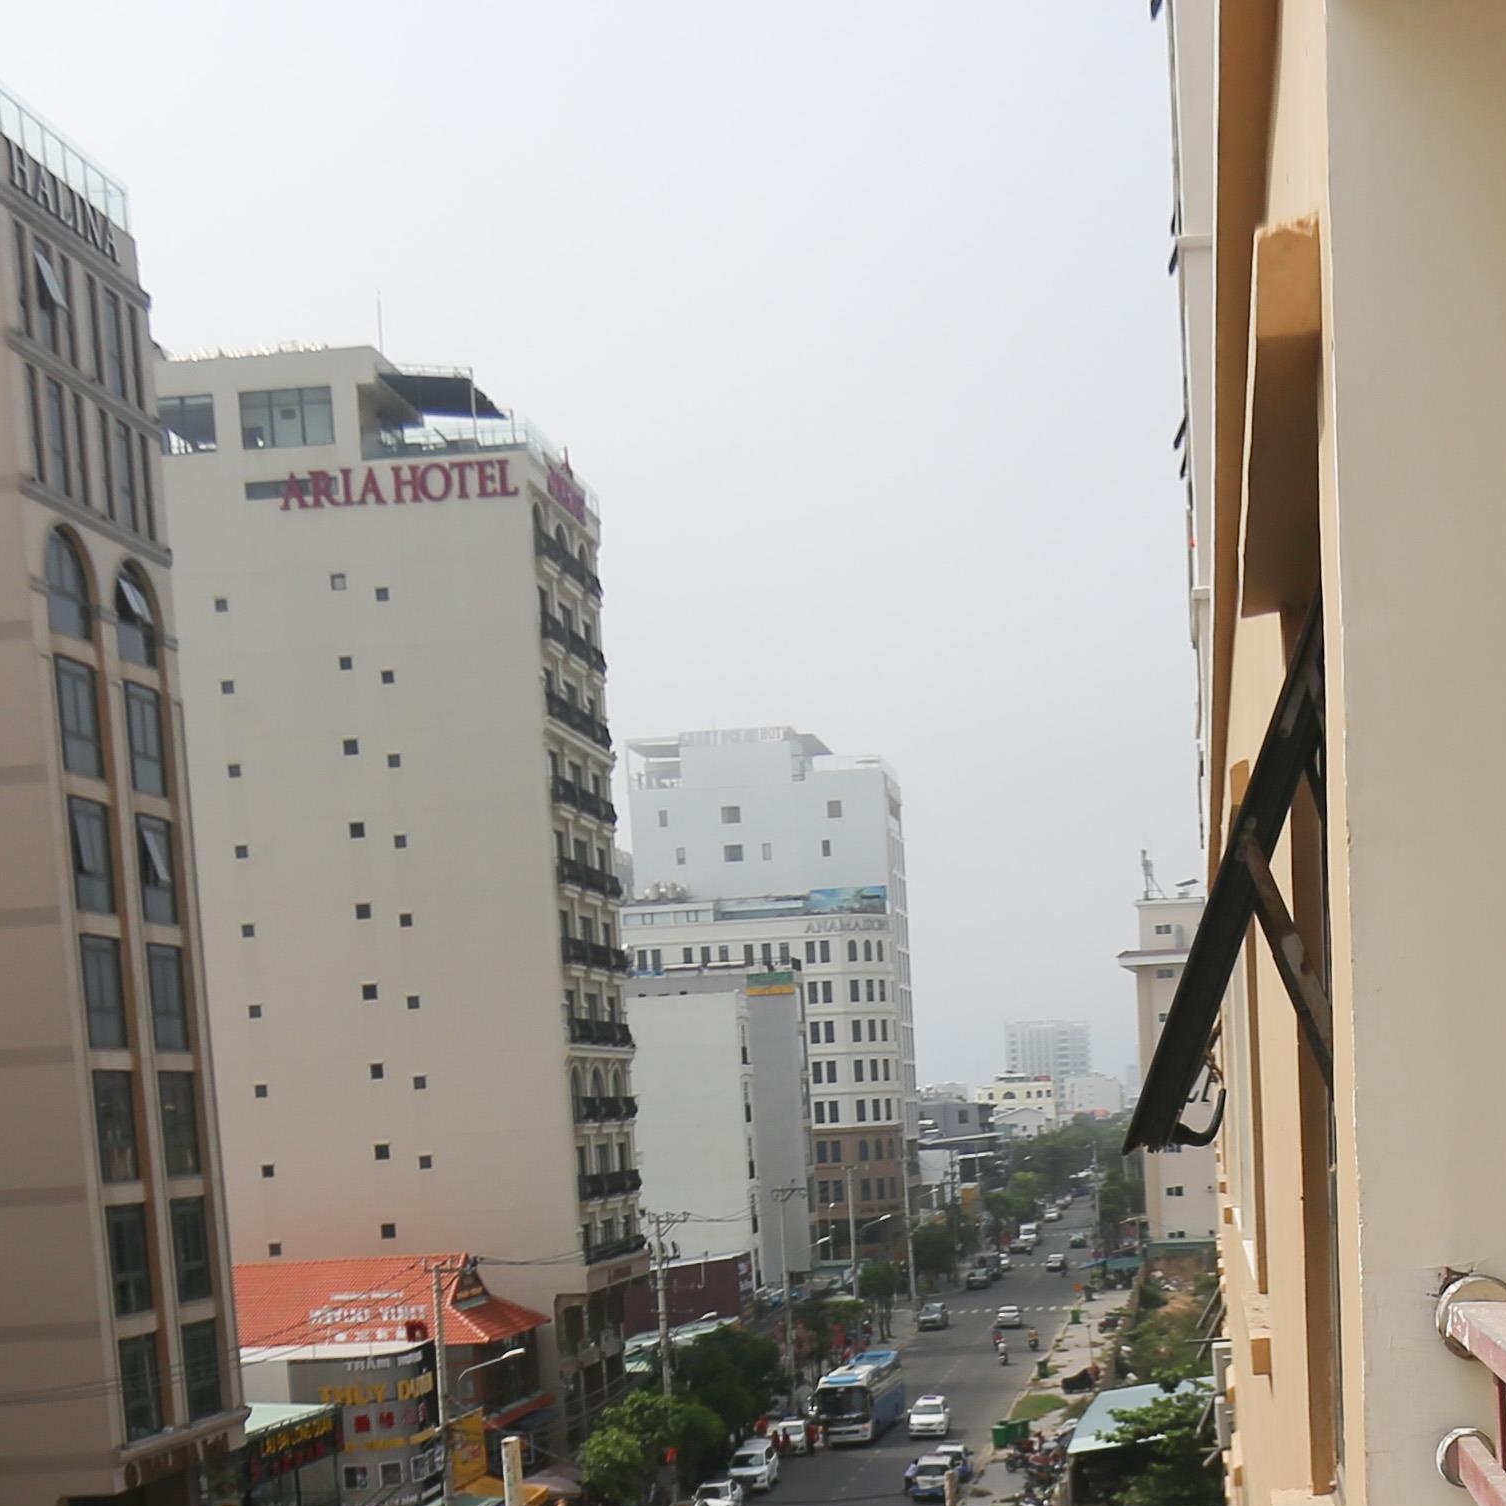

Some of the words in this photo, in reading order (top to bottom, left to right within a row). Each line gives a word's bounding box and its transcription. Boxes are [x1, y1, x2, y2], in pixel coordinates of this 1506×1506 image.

[5, 137, 123, 266] HALINA
[280, 467, 388, 511] ARIA
[390, 459, 520, 505] HOTEL
